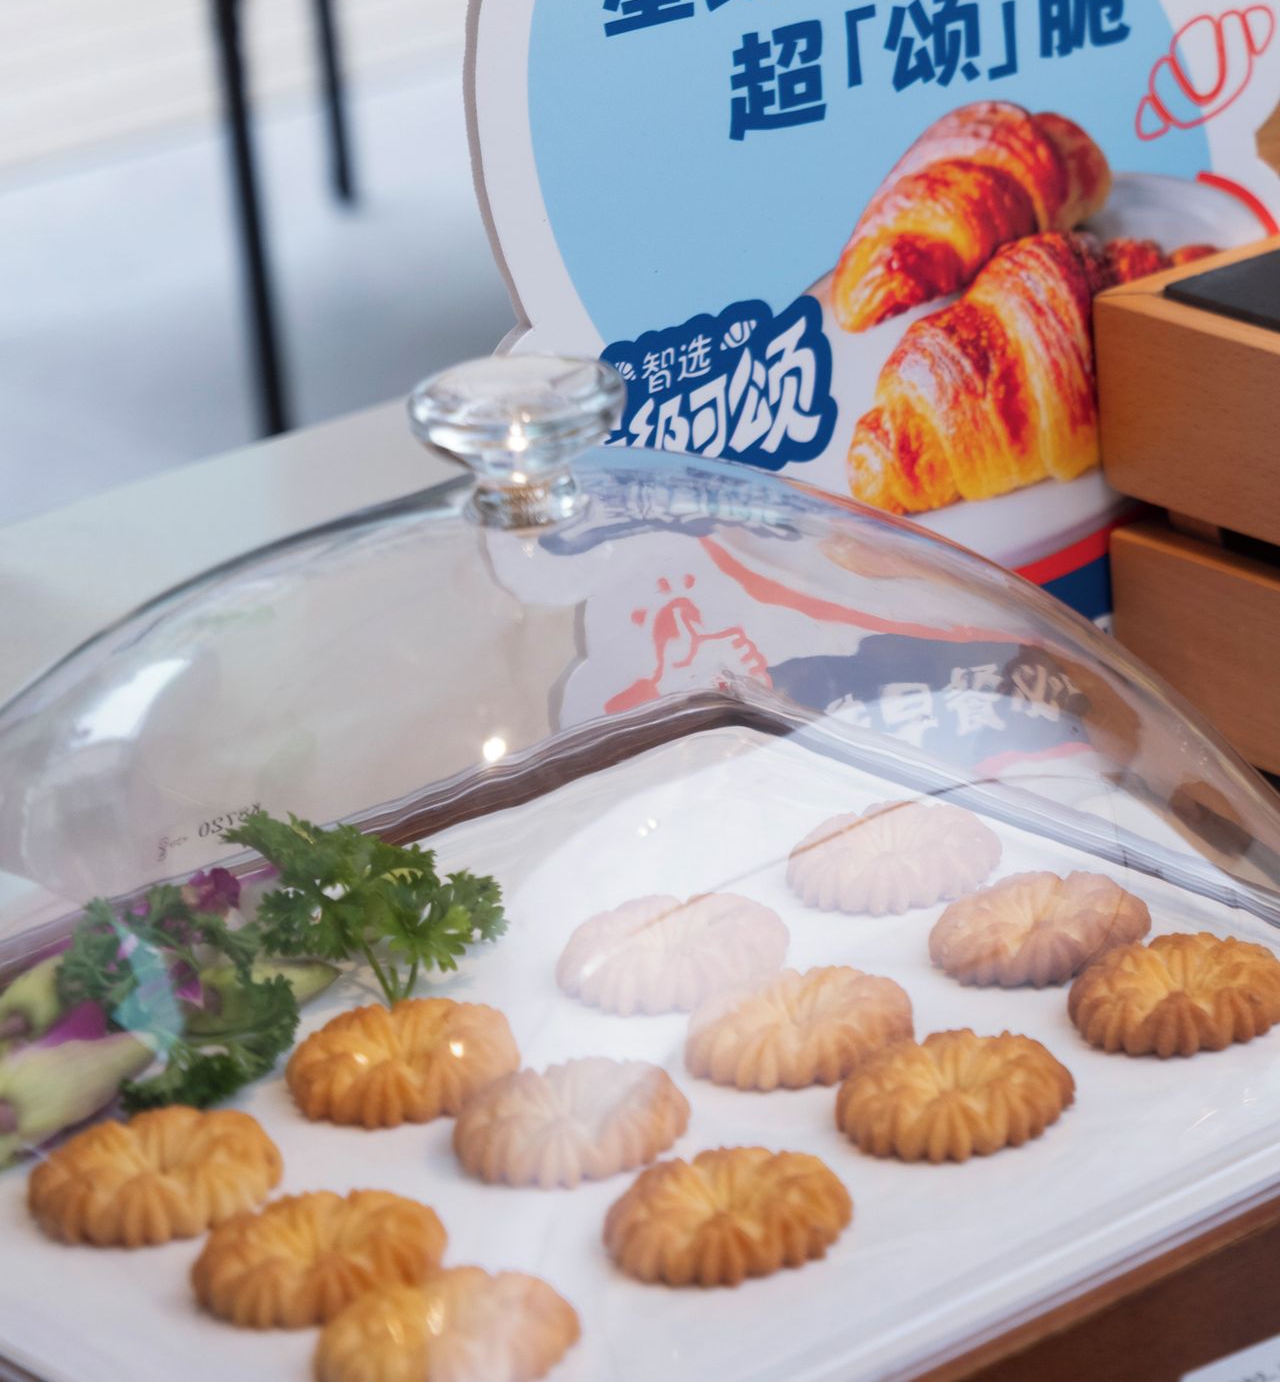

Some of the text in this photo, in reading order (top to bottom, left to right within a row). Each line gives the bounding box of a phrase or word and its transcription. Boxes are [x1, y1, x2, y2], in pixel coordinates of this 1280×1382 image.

[604, 316, 822, 459] 级可颂
[641, 334, 712, 394] 智选
